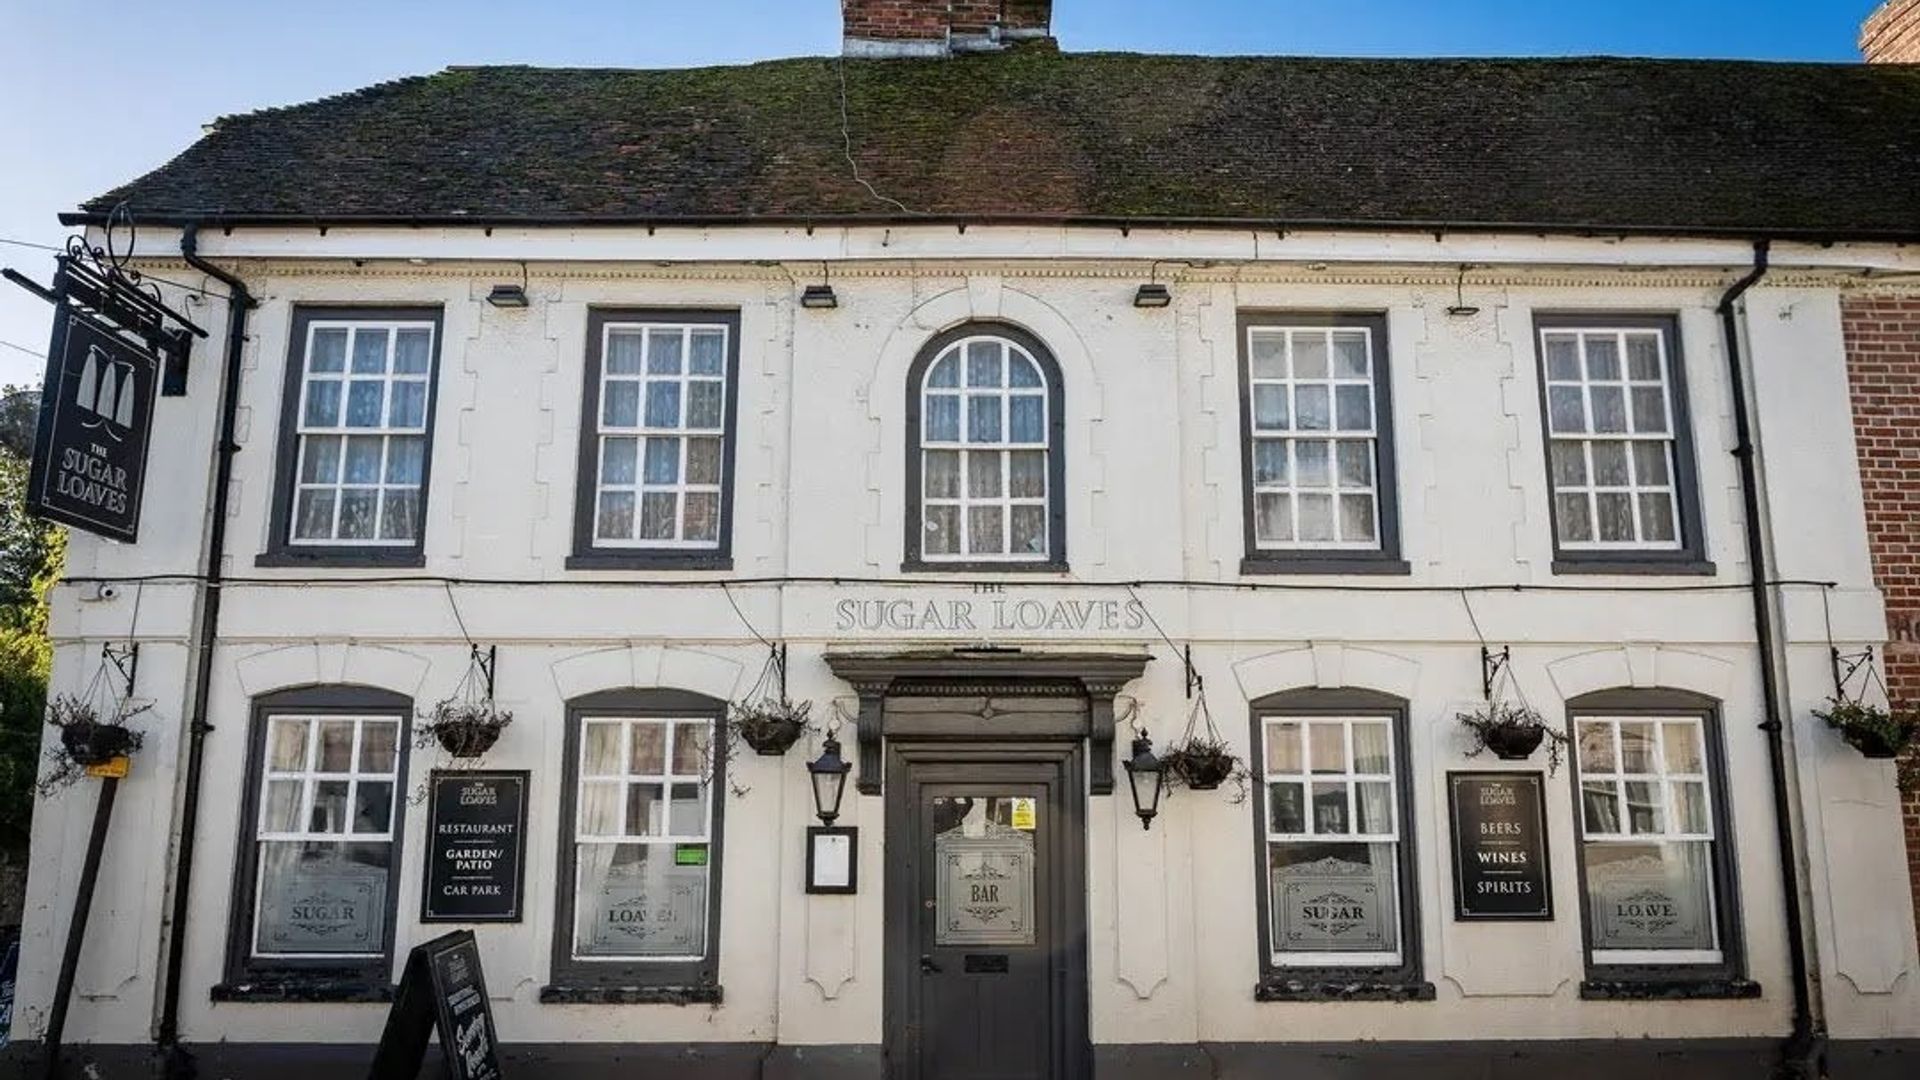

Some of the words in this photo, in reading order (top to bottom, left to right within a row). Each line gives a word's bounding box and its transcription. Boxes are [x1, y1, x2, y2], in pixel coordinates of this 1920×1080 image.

[62, 448, 128, 491] SUGAR
[57, 470, 127, 514] LOAVES
[973, 580, 1006, 594] THE
[836, 599, 977, 631] SUGAR
[992, 599, 1146, 631] LOAVES
[439, 824, 514, 834] RESTAURANT
[1480, 822, 1522, 835] BEERS
[446, 849, 504, 859] GARDEN/
[1477, 852, 1527, 864] WINES
[456, 860, 493, 870] PATIO
[443, 885, 469, 896] CAR
[471, 885, 502, 896] PARK
[971, 884, 999, 902] BAR
[1477, 881, 1532, 894] SPIRITS
[291, 906, 355, 920] SUGAR
[609, 909, 677, 923] LOAE
[1302, 906, 1365, 920] SUGAR
[1617, 904, 1677, 917] LOAVE
